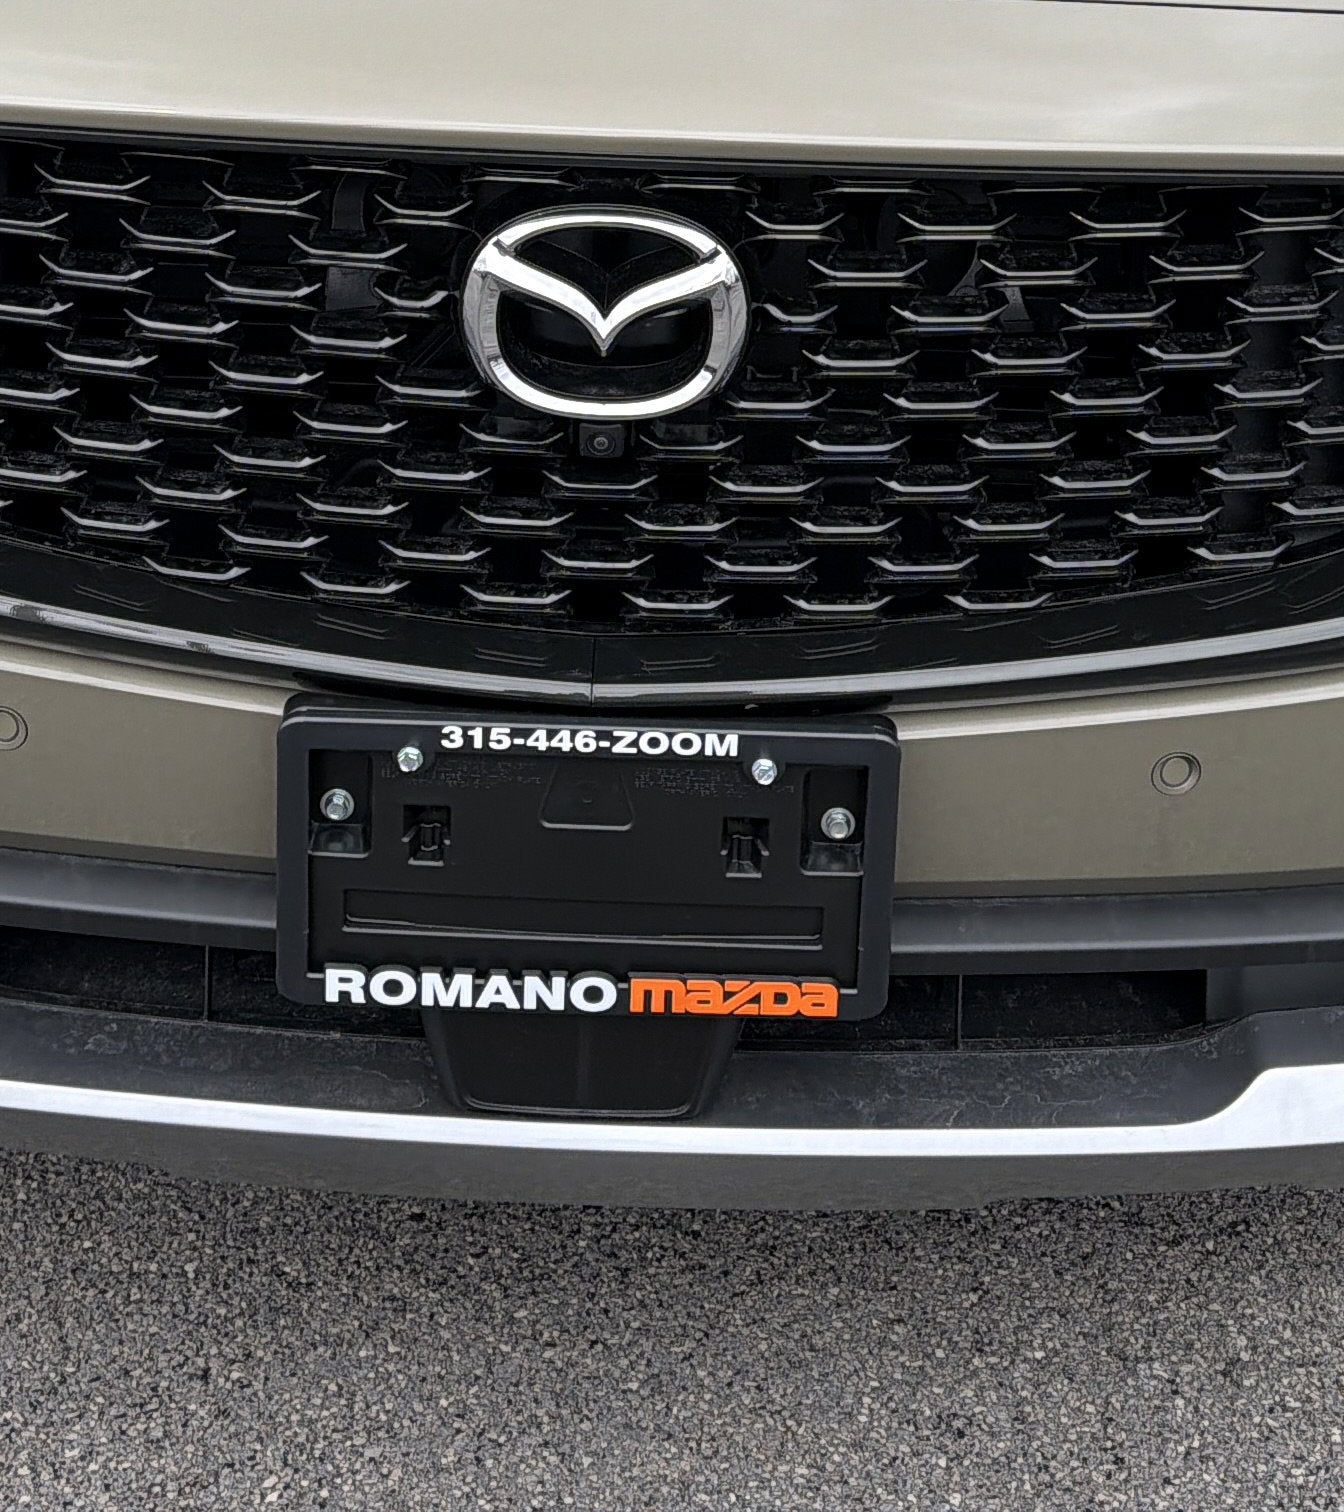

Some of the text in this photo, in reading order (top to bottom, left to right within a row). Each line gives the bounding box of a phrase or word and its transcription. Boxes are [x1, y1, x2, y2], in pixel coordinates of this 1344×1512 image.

[440, 725, 740, 757] 315-446-ZOOM
[325, 968, 839, 1018] ROMANO mazda
